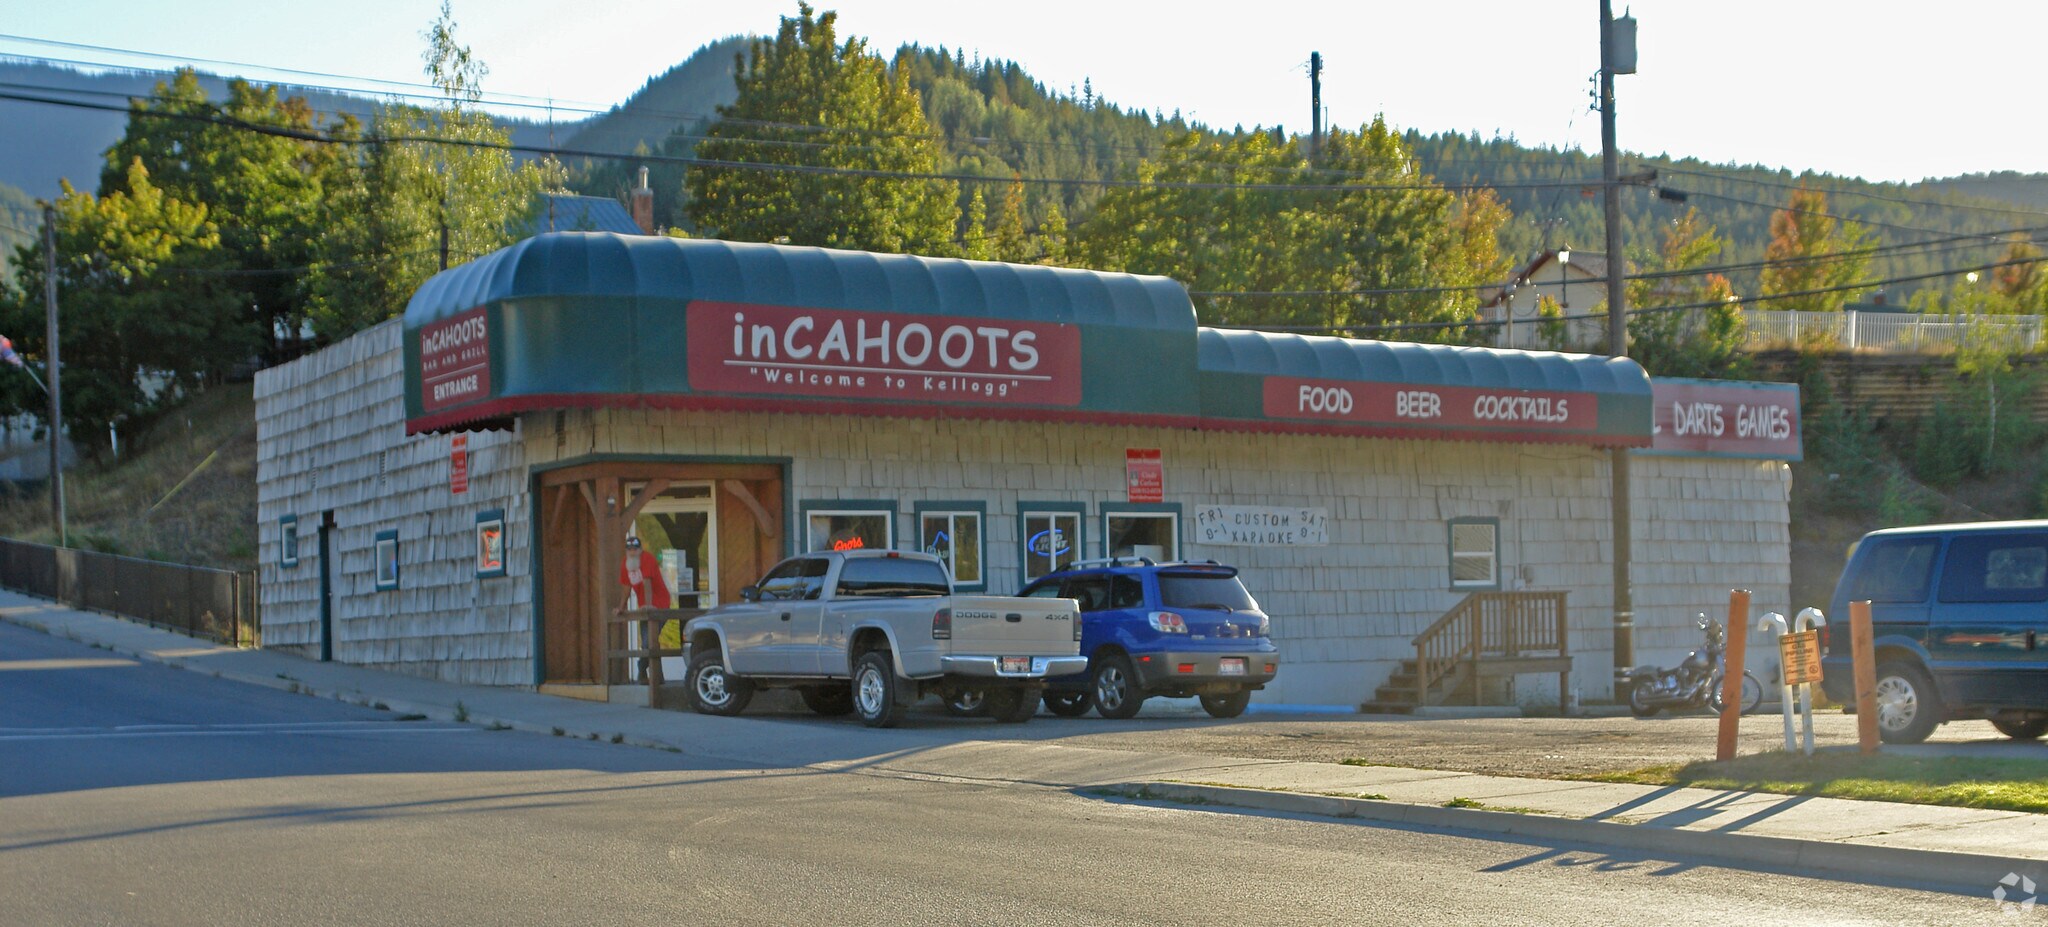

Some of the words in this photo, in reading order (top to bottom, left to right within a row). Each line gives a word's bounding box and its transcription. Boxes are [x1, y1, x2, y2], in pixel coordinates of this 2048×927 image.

[422, 315, 487, 355] inCAHOOTS
[733, 312, 1039, 371] inCAHOOTS
[424, 359, 437, 372] BAR
[442, 353, 457, 366] AND
[461, 344, 486, 361] GRILL
[433, 374, 479, 401] ENTRANCE
[884, 375, 906, 389] to
[1299, 385, 1354, 415] FOOD
[1396, 391, 1442, 418] BEER
[1474, 395, 1569, 422] COCKTAILS
[1674, 401, 1725, 436] DARTS
[1736, 403, 1791, 439] GAMES
[1198, 507, 1223, 526] FRI
[1235, 512, 1289, 527] CUSTOM
[1301, 510, 1325, 528] SAT
[955, 611, 997, 619] DODGE
